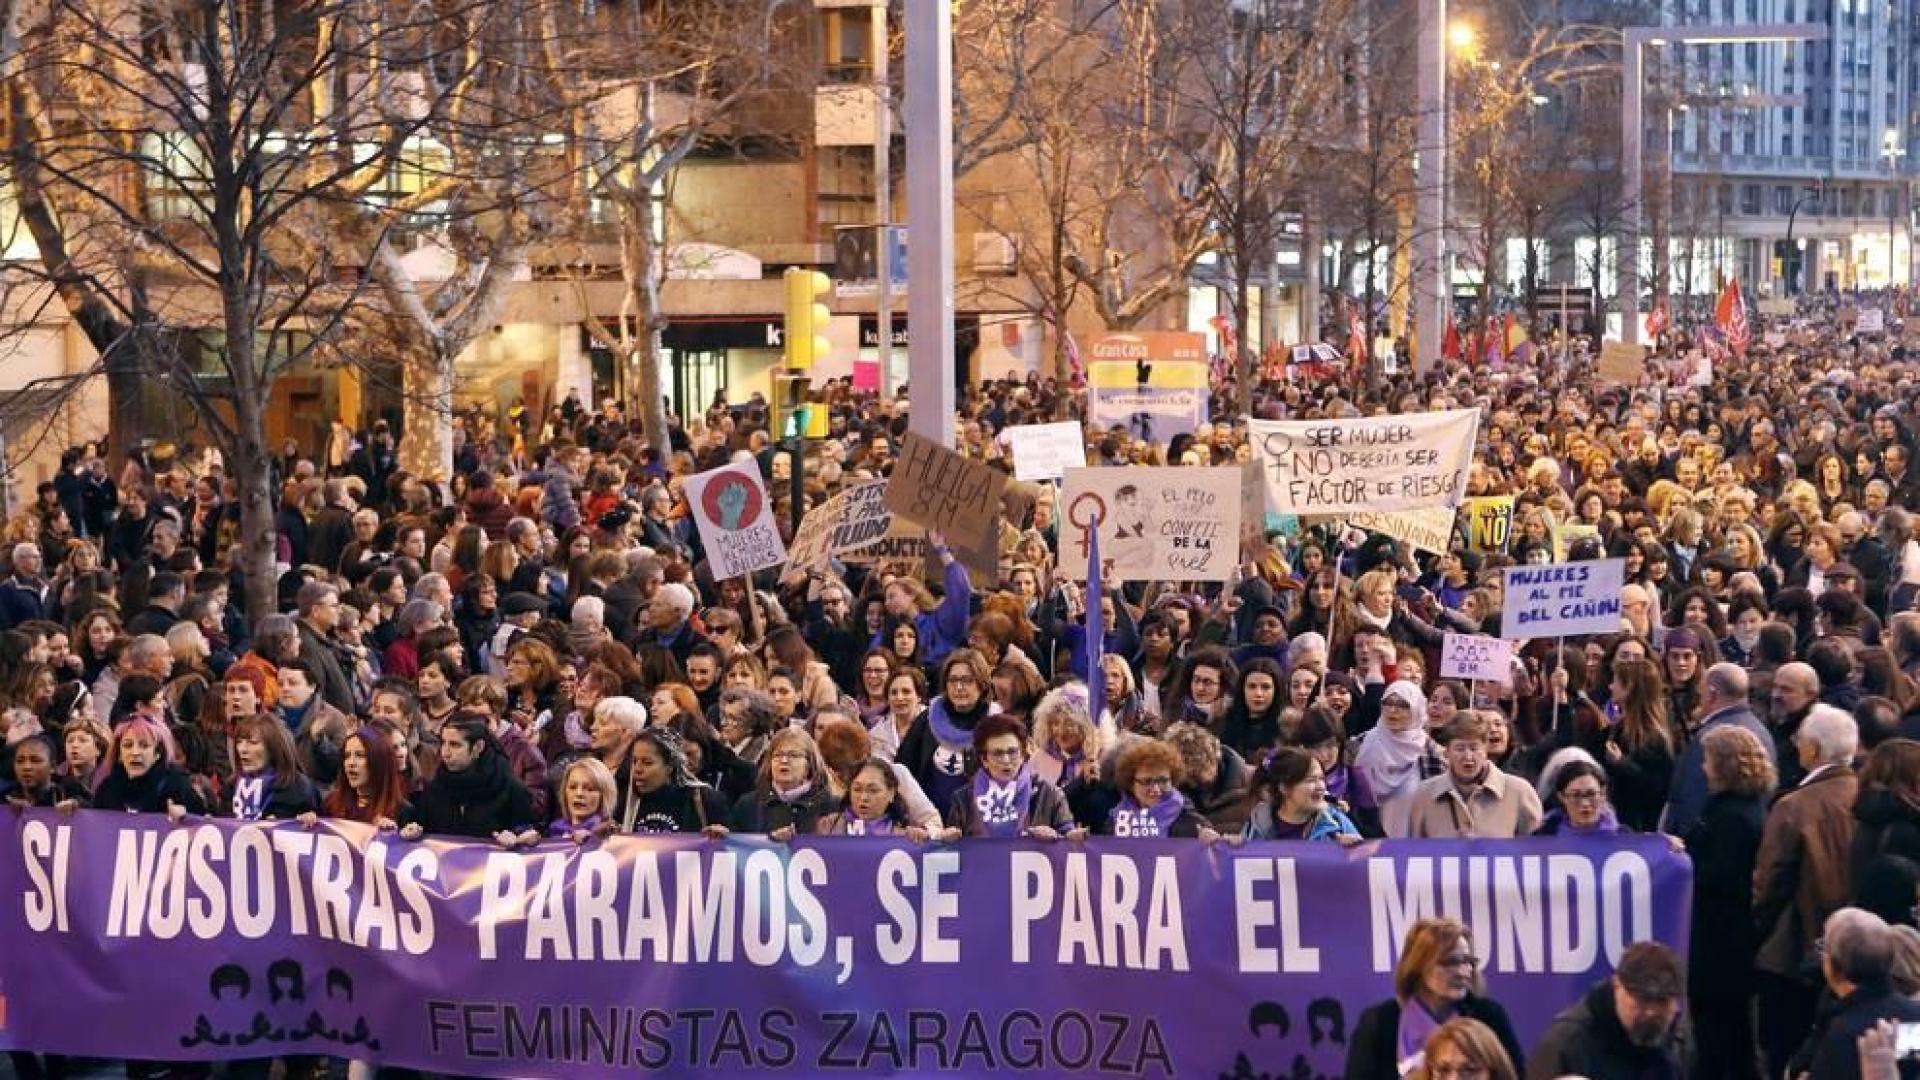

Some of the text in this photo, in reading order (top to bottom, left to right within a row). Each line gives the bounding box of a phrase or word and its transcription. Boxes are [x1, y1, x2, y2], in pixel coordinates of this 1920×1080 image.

[1305, 424, 1415, 448] SER MUJER
[905, 440, 992, 513] HUELGA
[1293, 449, 1333, 477] NO
[1405, 450, 1438, 466] SER
[1289, 477, 1367, 508] FACTOR
[1377, 482, 1395, 496] DE
[1173, 536, 1211, 550] DE LA
[1480, 516, 1507, 547] NO
[1510, 566, 1589, 586] MUJERES
[1530, 588, 1550, 600] AL
[1519, 608, 1552, 624] DEL
[22, 821, 1653, 985] SI NOSOTRAS PARAMOS, SE PARA EL MUNDO
[427, 1000, 1175, 1077] FEMINISTAS ZARAGOZA
